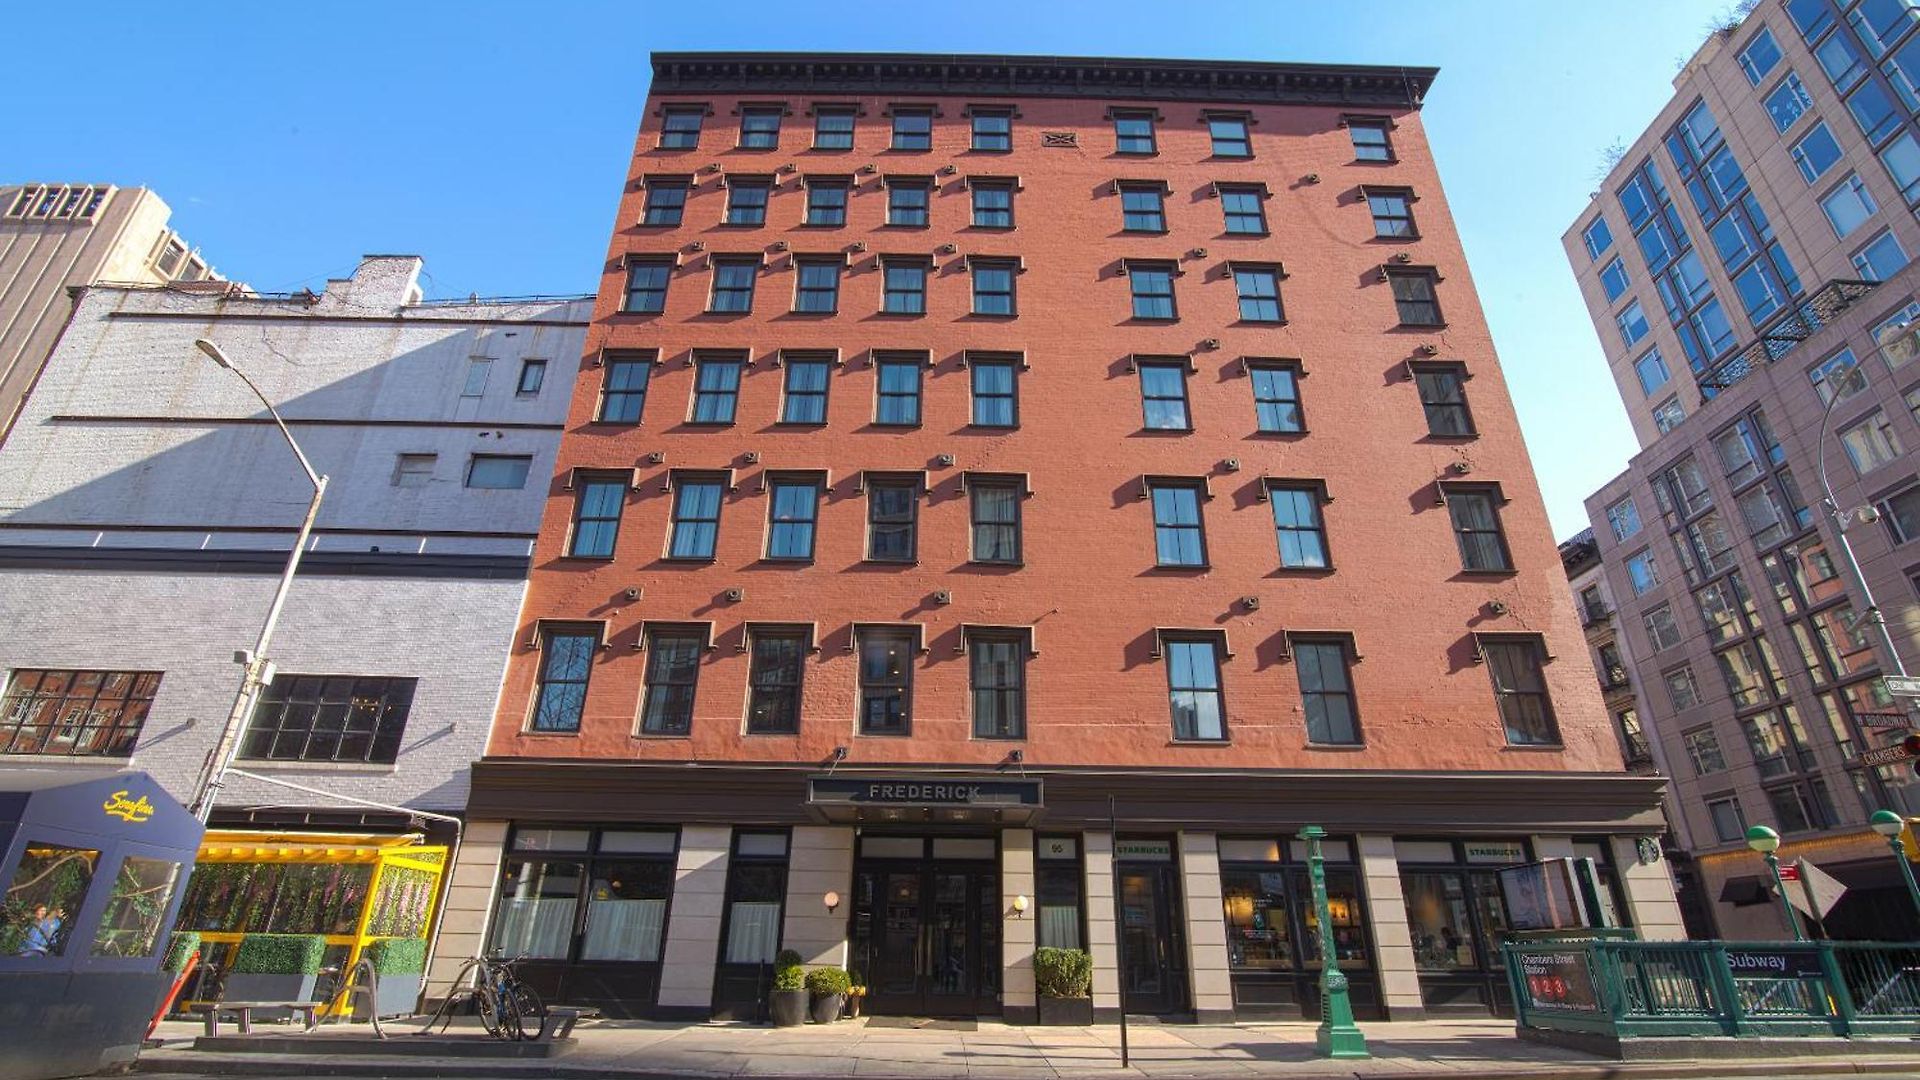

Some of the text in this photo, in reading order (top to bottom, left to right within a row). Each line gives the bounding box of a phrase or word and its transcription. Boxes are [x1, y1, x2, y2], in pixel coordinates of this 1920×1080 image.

[869, 785, 981, 799] FREDERICK
[1117, 846, 1169, 855] STARBUCKS
[1469, 848, 1521, 856] STARBUCKS
[1554, 953, 1576, 965] Street
[1727, 952, 1786, 971] Subway
[1523, 964, 1548, 975] Station
